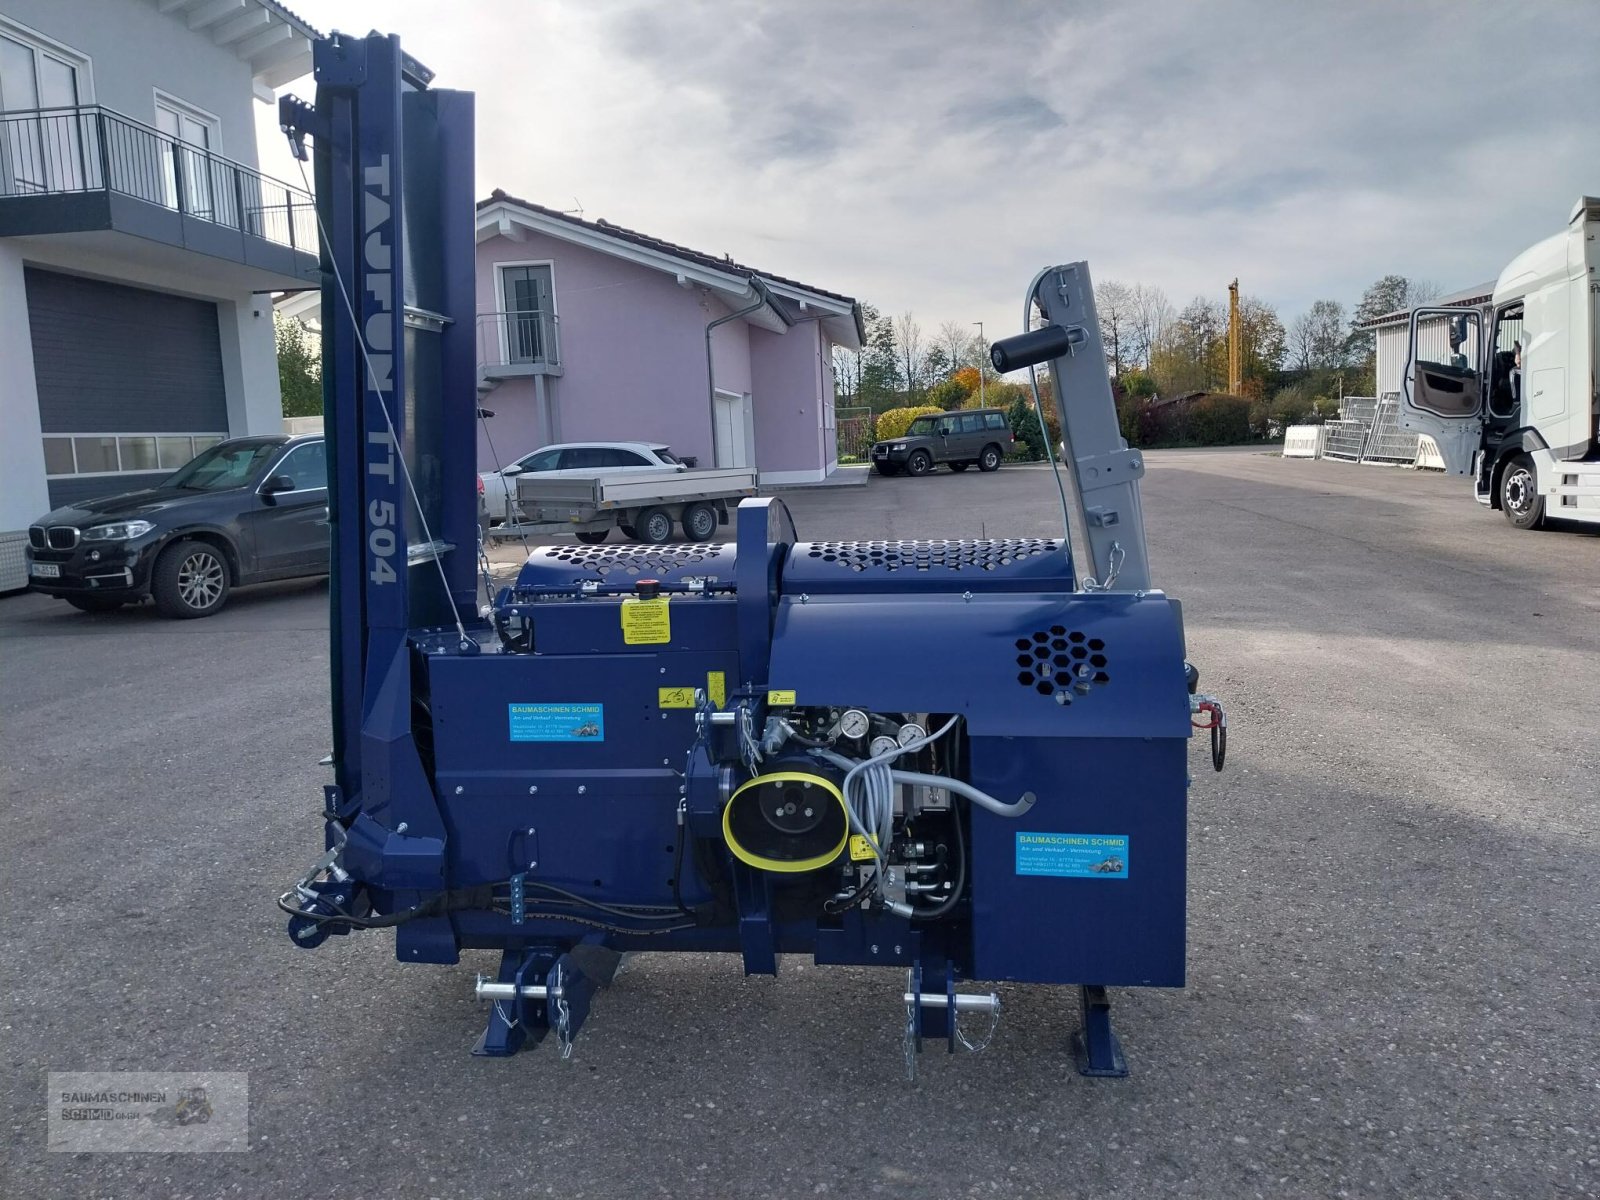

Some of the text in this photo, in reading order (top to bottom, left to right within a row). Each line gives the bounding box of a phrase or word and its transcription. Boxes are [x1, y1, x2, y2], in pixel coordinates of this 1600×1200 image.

[364, 153, 397, 586] TAJFUN TT 504
[1019, 835, 1125, 847] BAUMASCHINEN SCHMID
